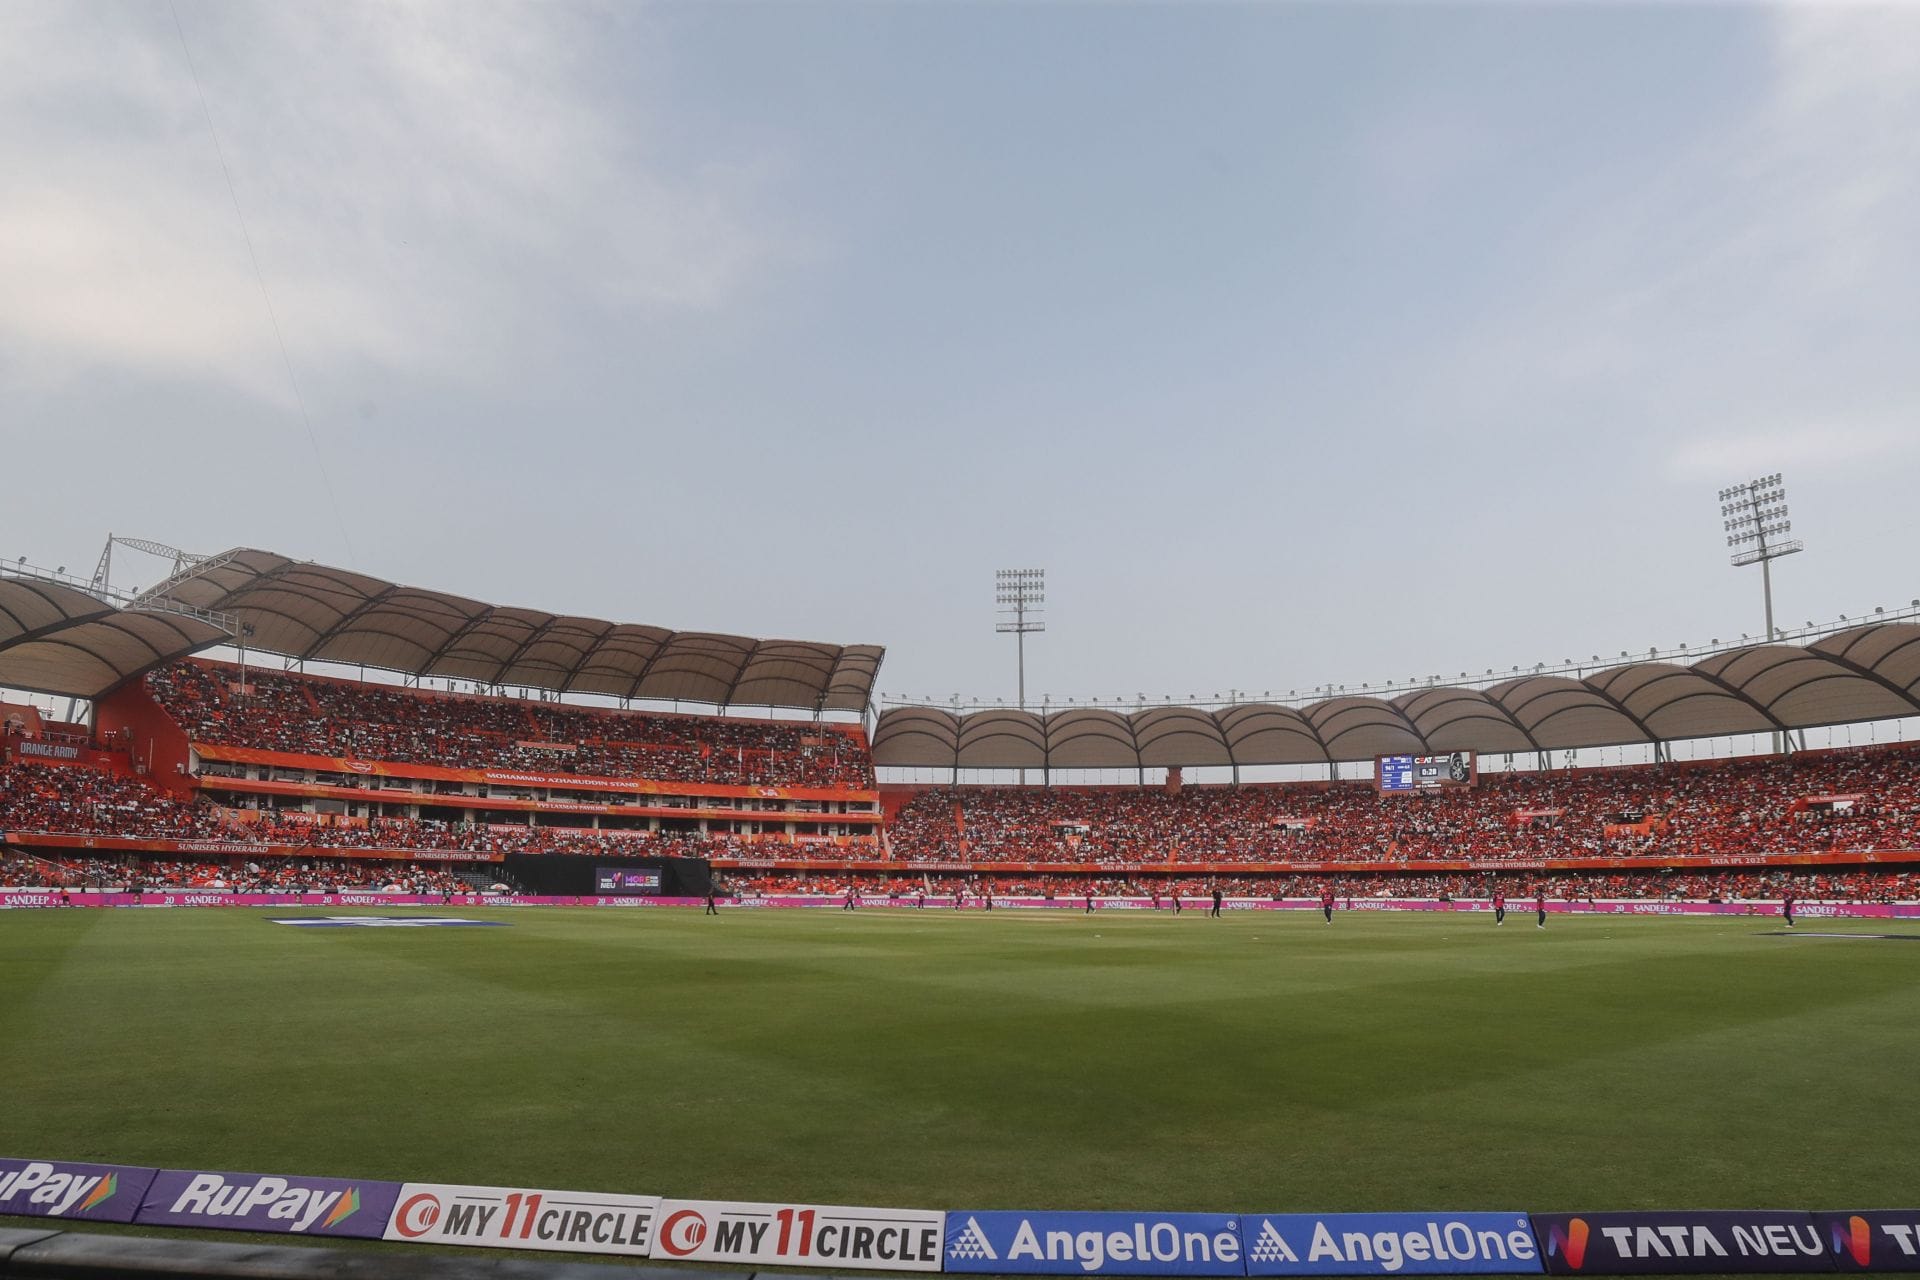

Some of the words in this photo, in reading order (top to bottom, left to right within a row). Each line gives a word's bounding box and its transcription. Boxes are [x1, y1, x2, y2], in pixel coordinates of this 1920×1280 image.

[20, 742, 54, 756] ORANGE
[54, 747, 78, 759] ARMY
[1414, 756, 1433, 764] CEAT
[486, 773, 545, 783] MOHAMMED
[548, 776, 608, 786] AZHARUDDIN
[178, 843, 221, 851] SUNRISERS
[221, 844, 269, 852] HYDERABAD
[5, 896, 49, 905] SANDEEP
[164, 896, 174, 904] 20
[185, 896, 222, 904] SANDEEP
[341, 895, 375, 903] SANDEEP
[483, 896, 514, 904] SANDEEP
[1615, 904, 1625, 912] 20
[1634, 904, 1670, 912] SANDEEP
[1795, 906, 1836, 914] SANDEEP
[169, 1173, 342, 1231] RuPay
[1601, 1226, 1729, 1258] TATA
[1731, 1226, 1823, 1256] NEU
[1881, 1224, 1920, 1255] T
[1008, 1219, 1239, 1271] AngelOne
[1309, 1221, 1535, 1272] AngelOne
